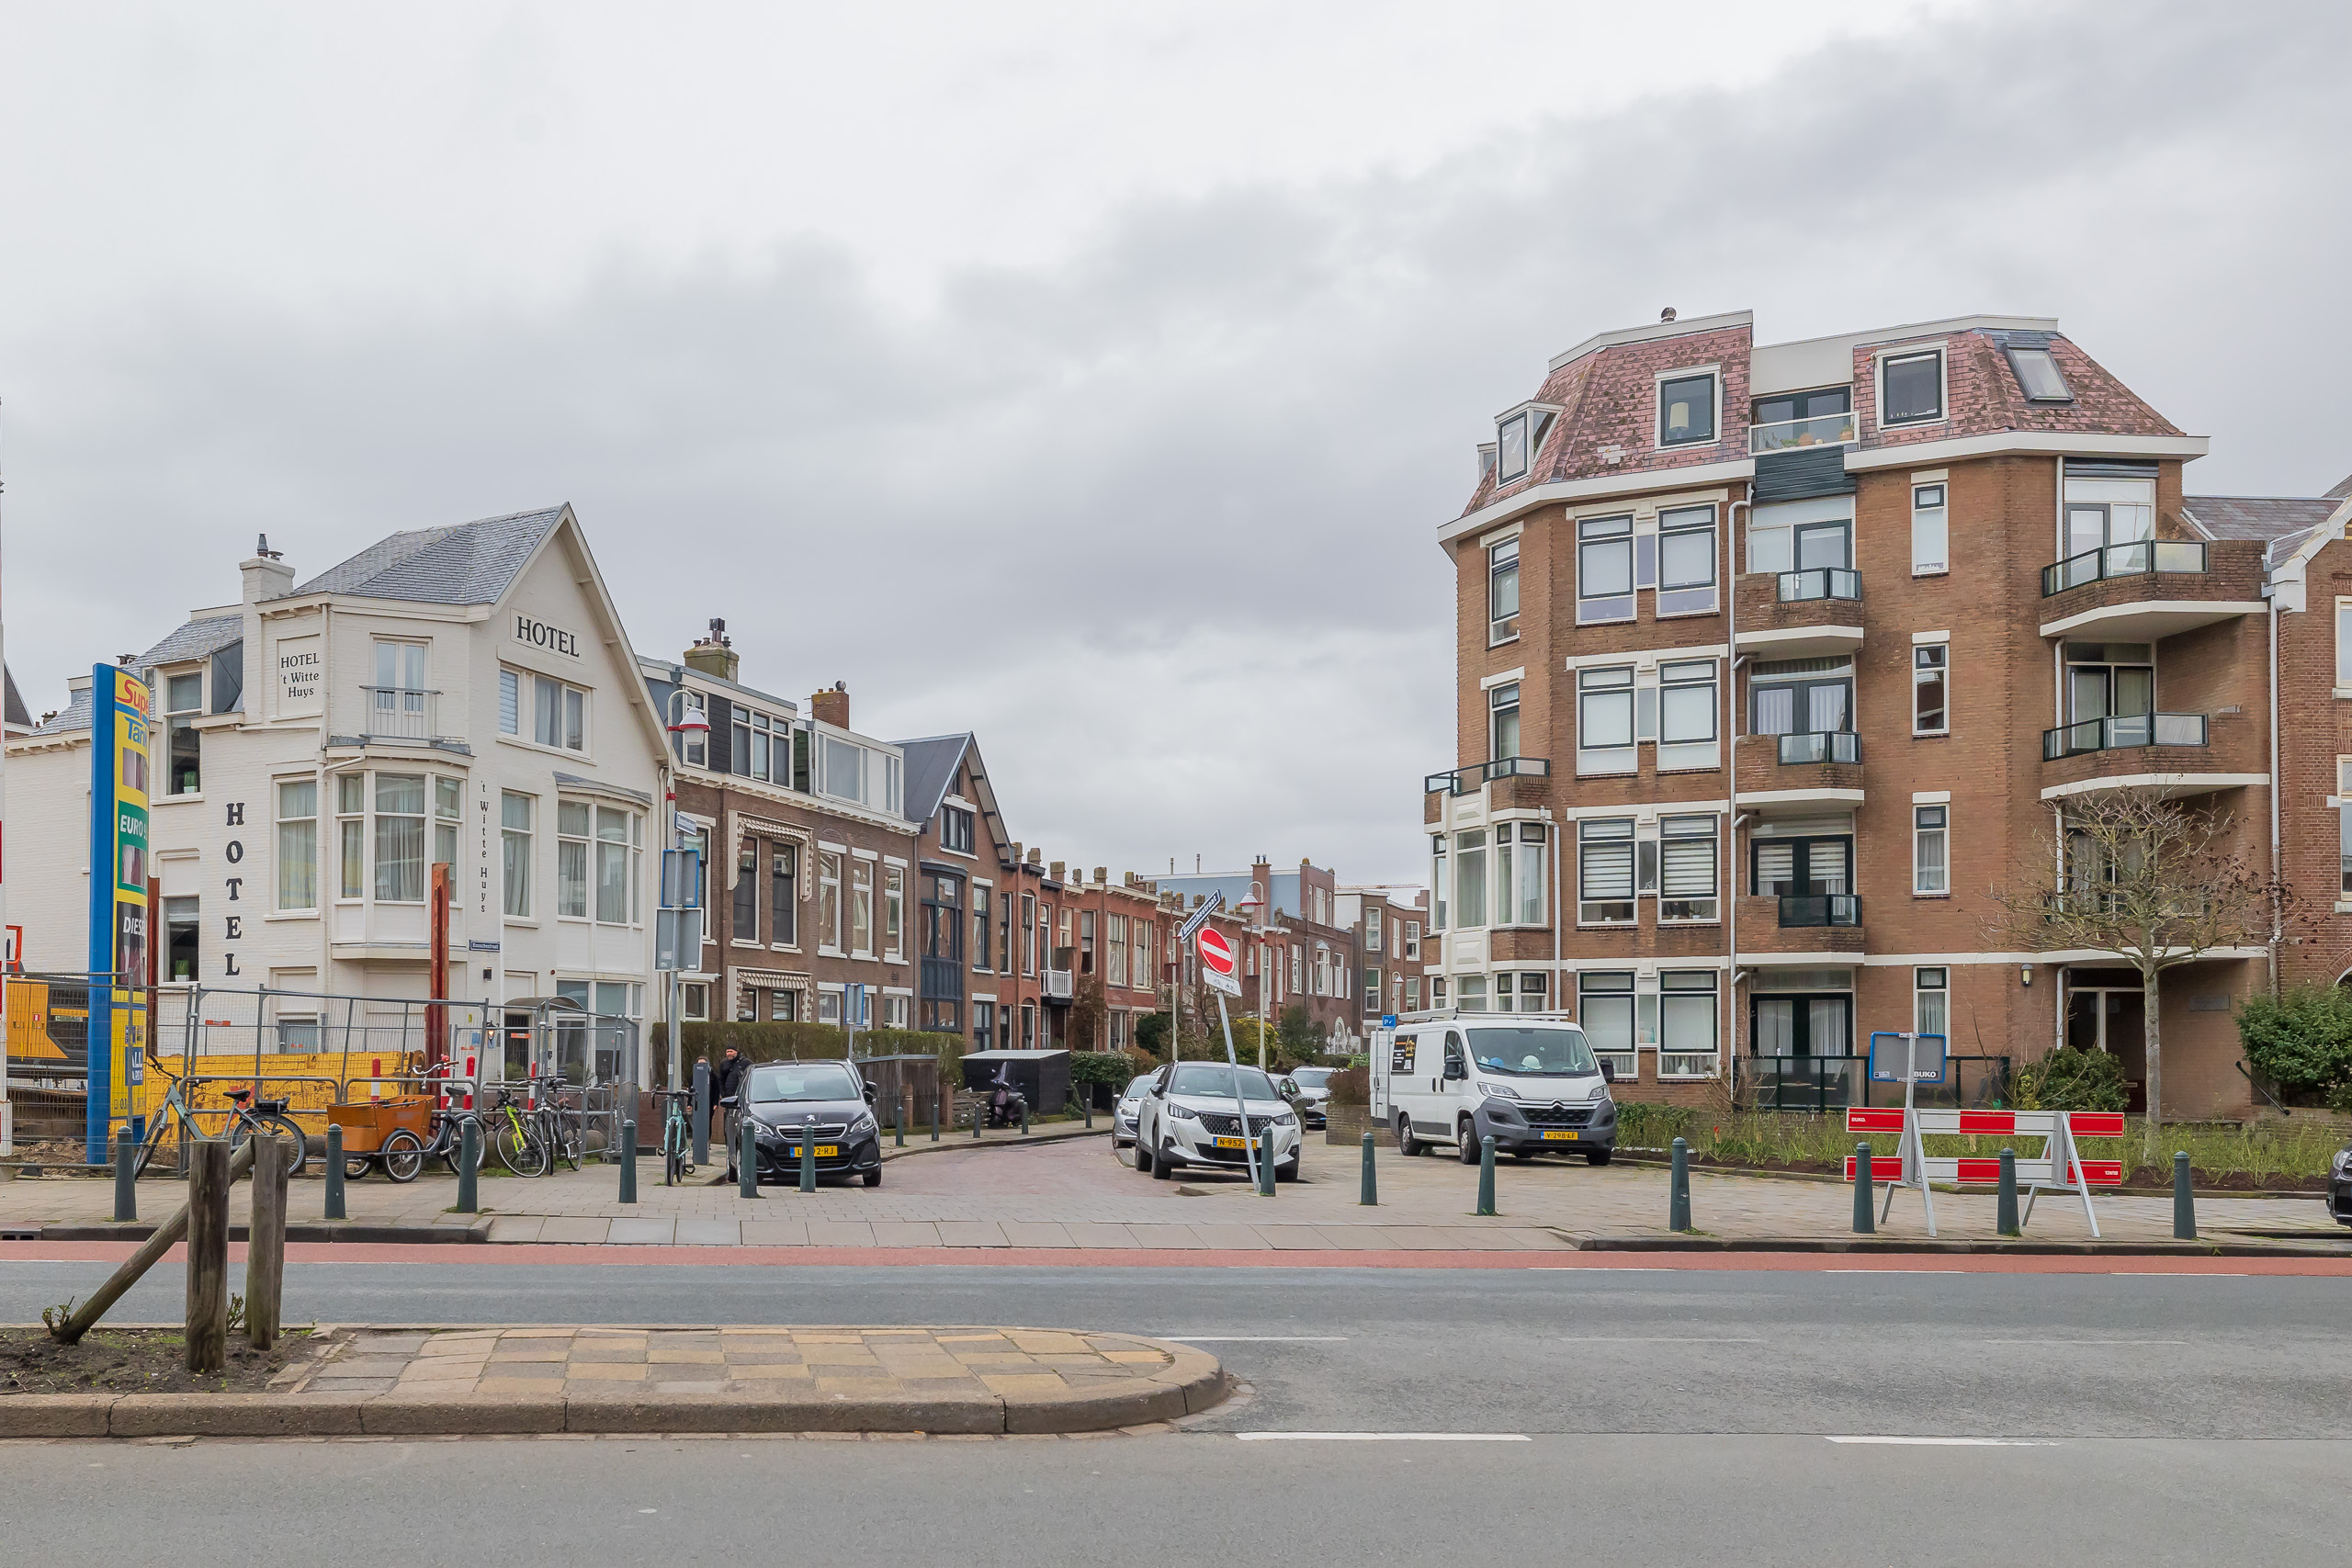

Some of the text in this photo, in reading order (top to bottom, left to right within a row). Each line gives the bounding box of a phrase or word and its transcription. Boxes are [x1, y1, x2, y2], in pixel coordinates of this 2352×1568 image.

[516, 615, 580, 658] HOTEL
[280, 652, 321, 669] HOTEL
[290, 671, 320, 683] Witte
[288, 686, 315, 699] Huys
[119, 814, 143, 838] EURO
[480, 800, 490, 859] Witte
[224, 802, 246, 976] HOTEL
[480, 866, 489, 913] Huys
[1182, 895, 1217, 935] Bosschestraat
